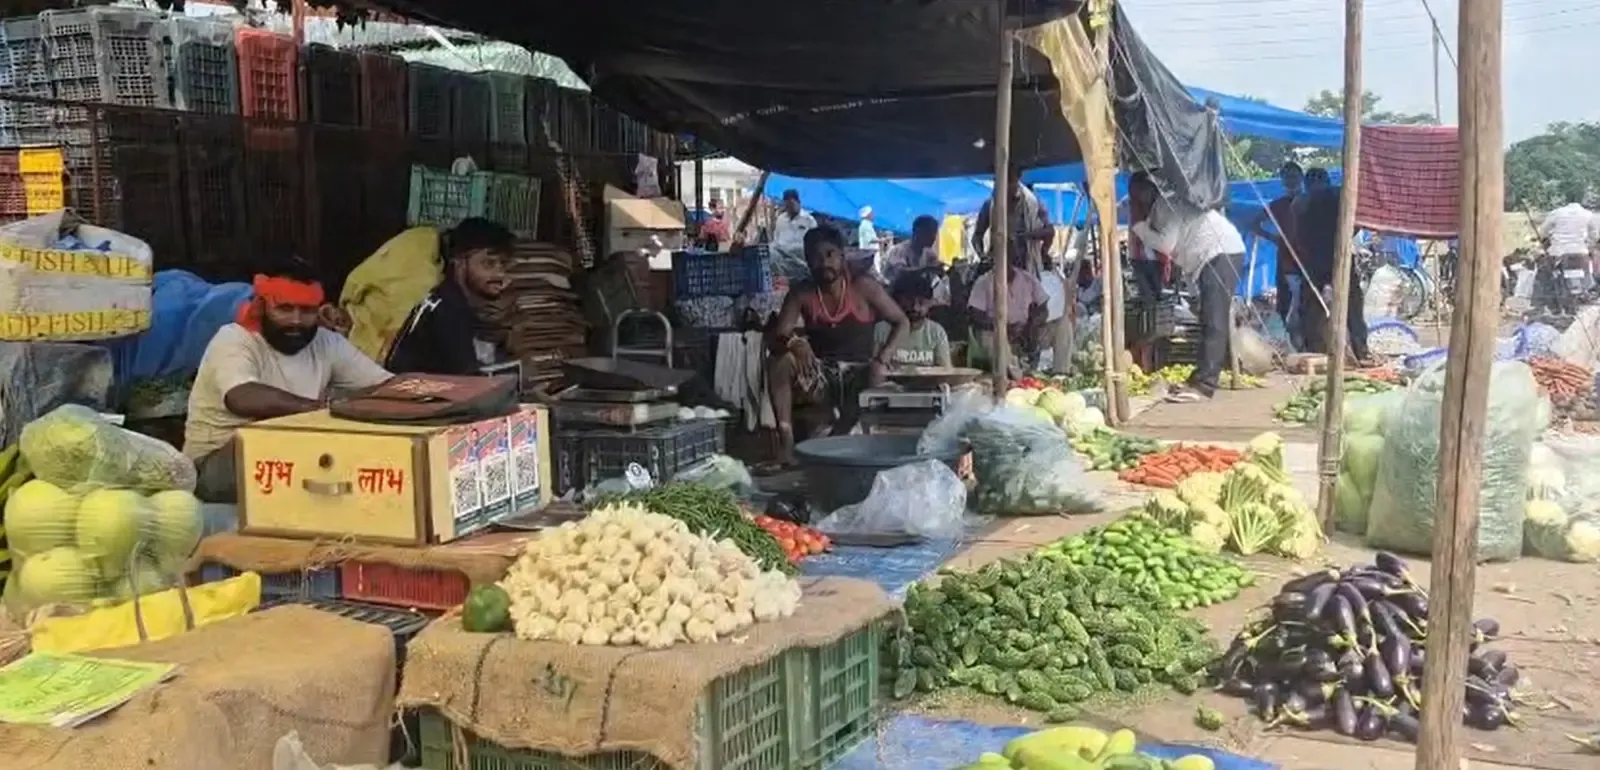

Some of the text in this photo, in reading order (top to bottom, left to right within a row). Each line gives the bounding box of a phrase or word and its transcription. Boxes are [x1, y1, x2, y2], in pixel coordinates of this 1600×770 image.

[893, 348, 934, 362] RDAN
[254, 459, 403, 494] शुभ लाभ
